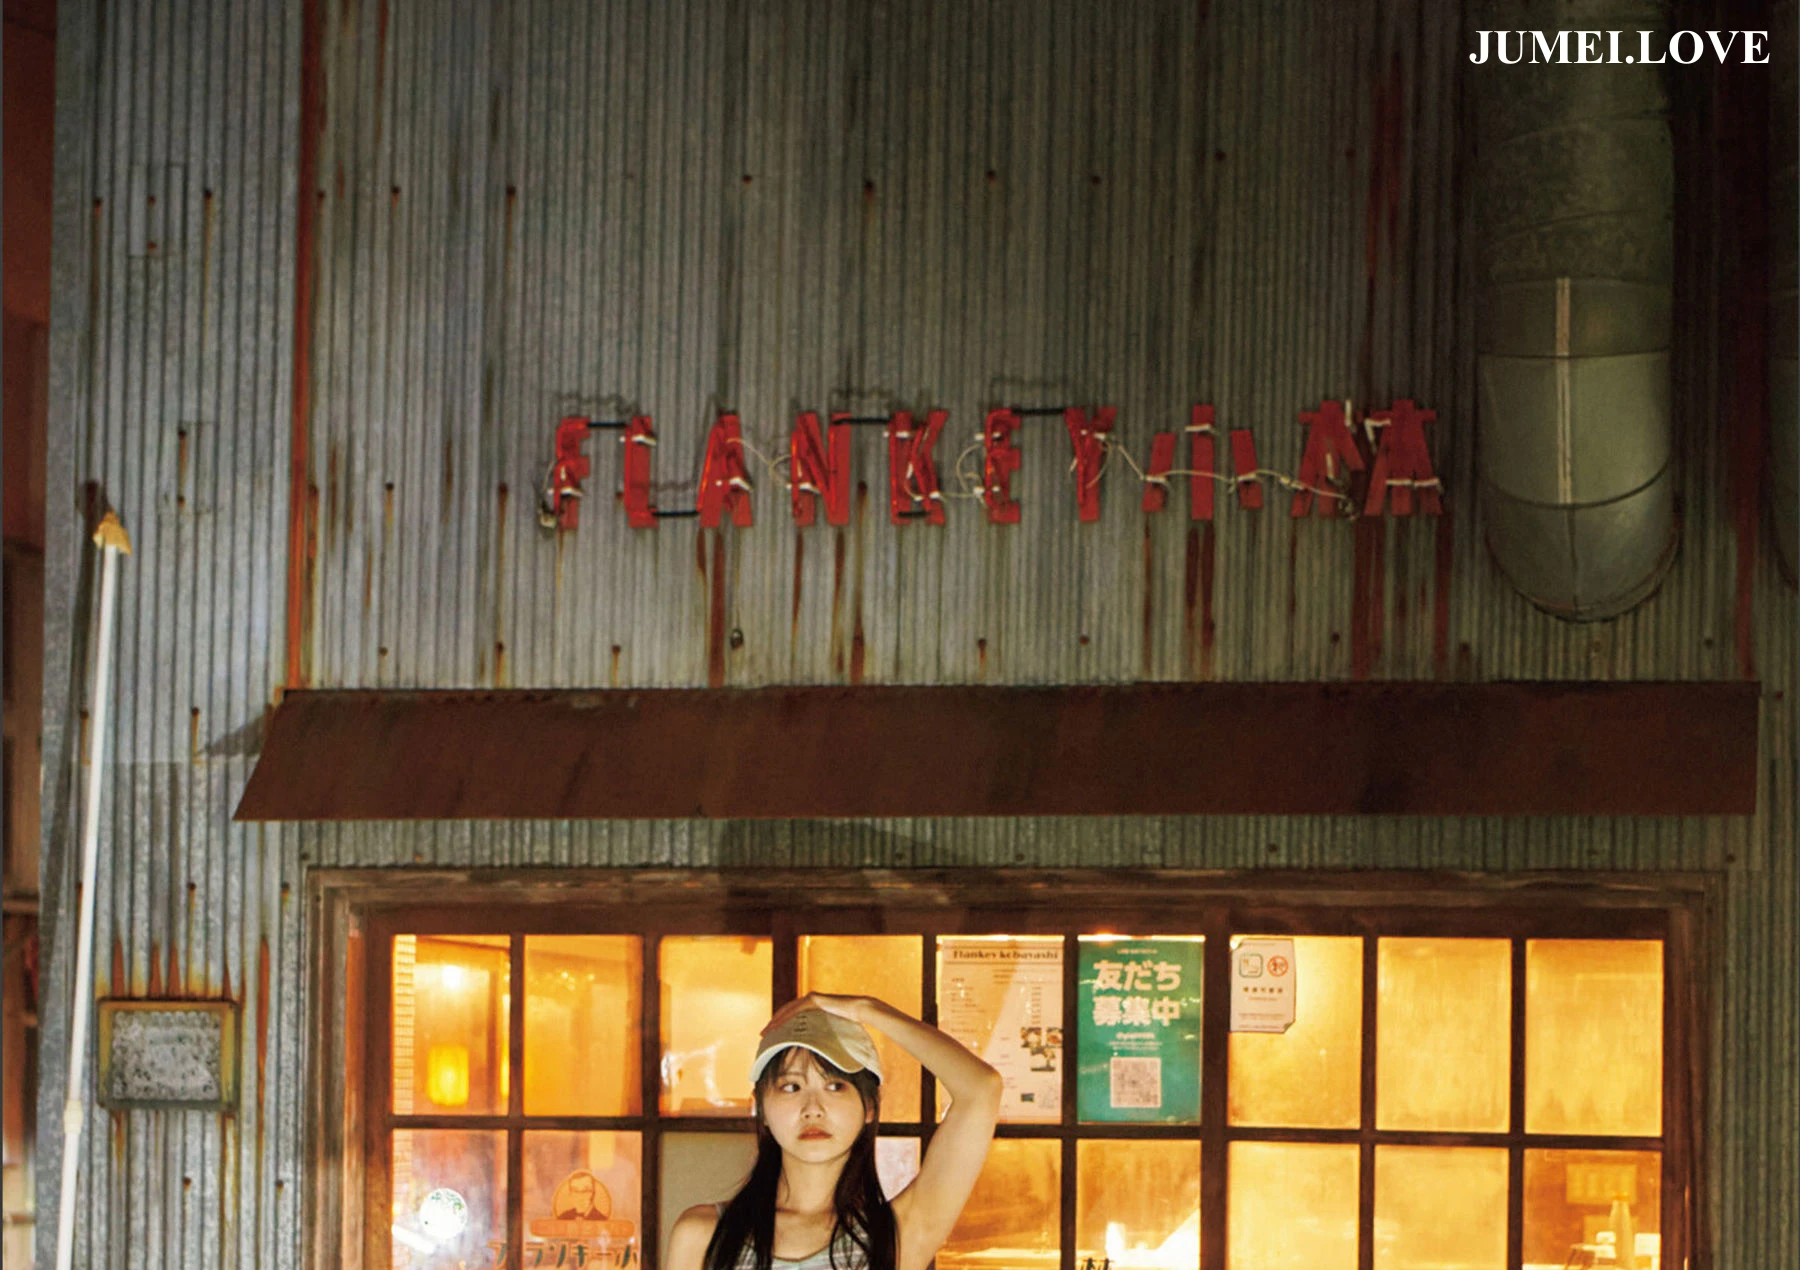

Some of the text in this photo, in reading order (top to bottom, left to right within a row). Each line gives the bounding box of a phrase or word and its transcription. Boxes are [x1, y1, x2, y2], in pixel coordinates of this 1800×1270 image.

[1093, 959, 1182, 991] 友だち
[1092, 995, 1181, 1026] 募集中
